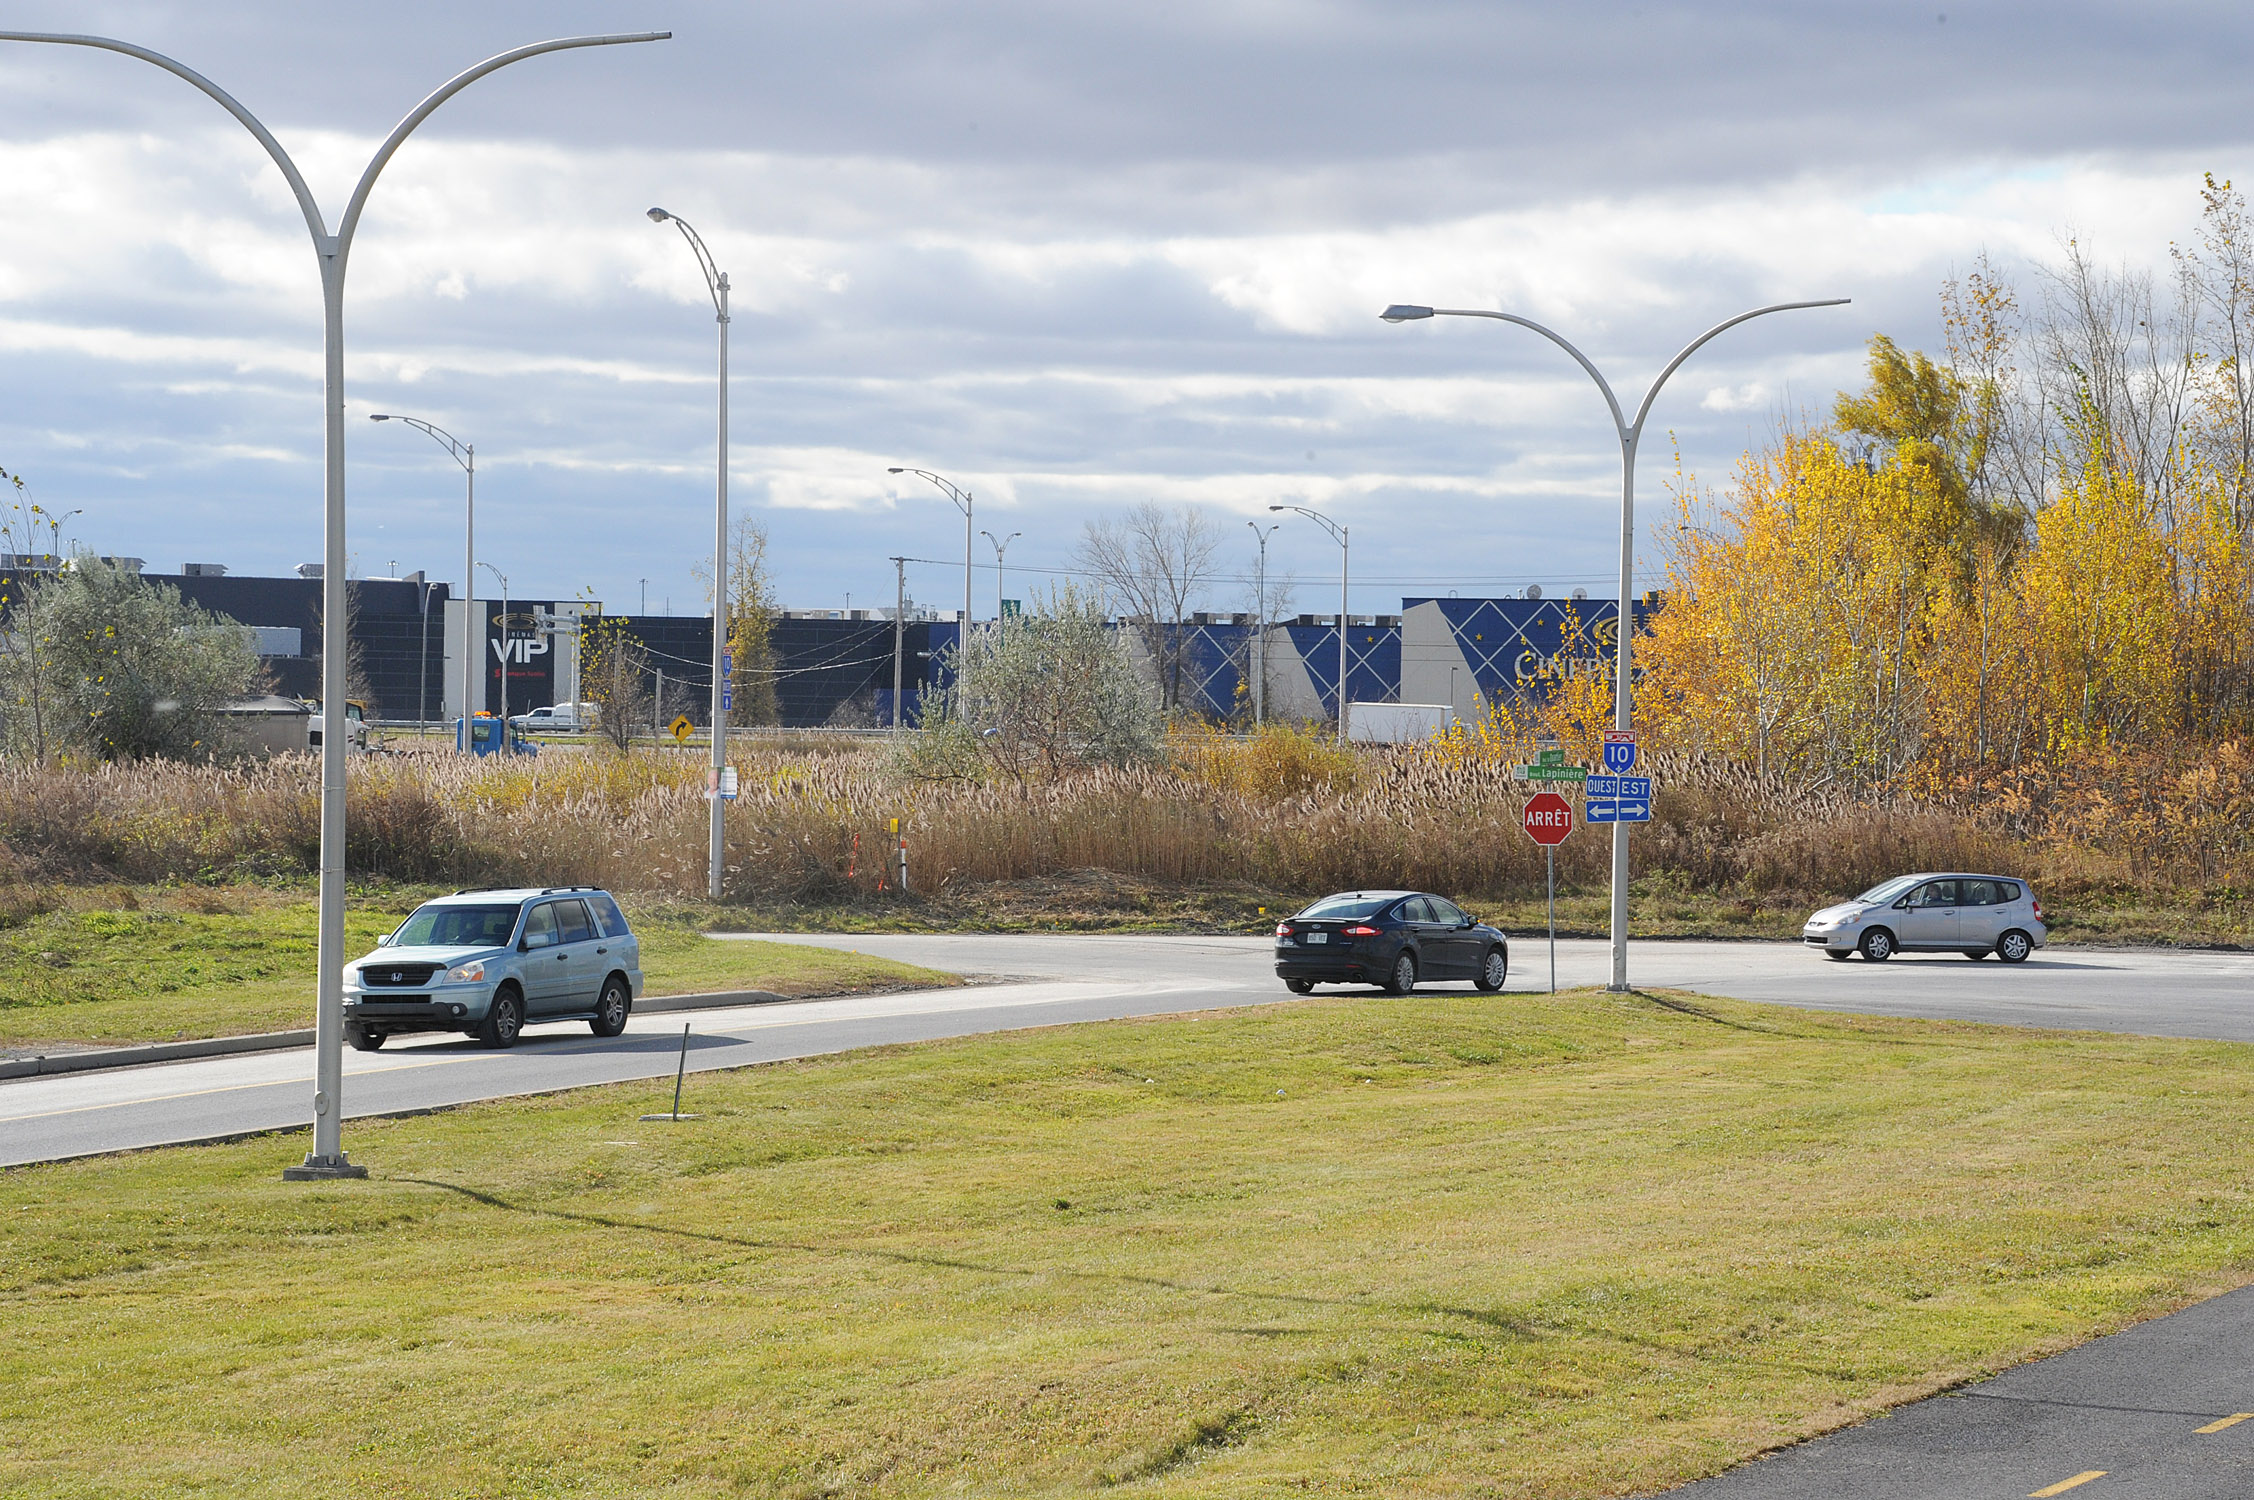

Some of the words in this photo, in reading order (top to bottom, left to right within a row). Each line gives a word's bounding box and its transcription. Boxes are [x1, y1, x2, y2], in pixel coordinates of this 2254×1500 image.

[491, 638, 548, 663] VIP
[1610, 746, 1628, 763] 10
[1542, 768, 1583, 779] Lapinière
[1588, 779, 1616, 793] OUEST
[1621, 781, 1647, 795] EST
[1526, 808, 1570, 826] ARRÊT
